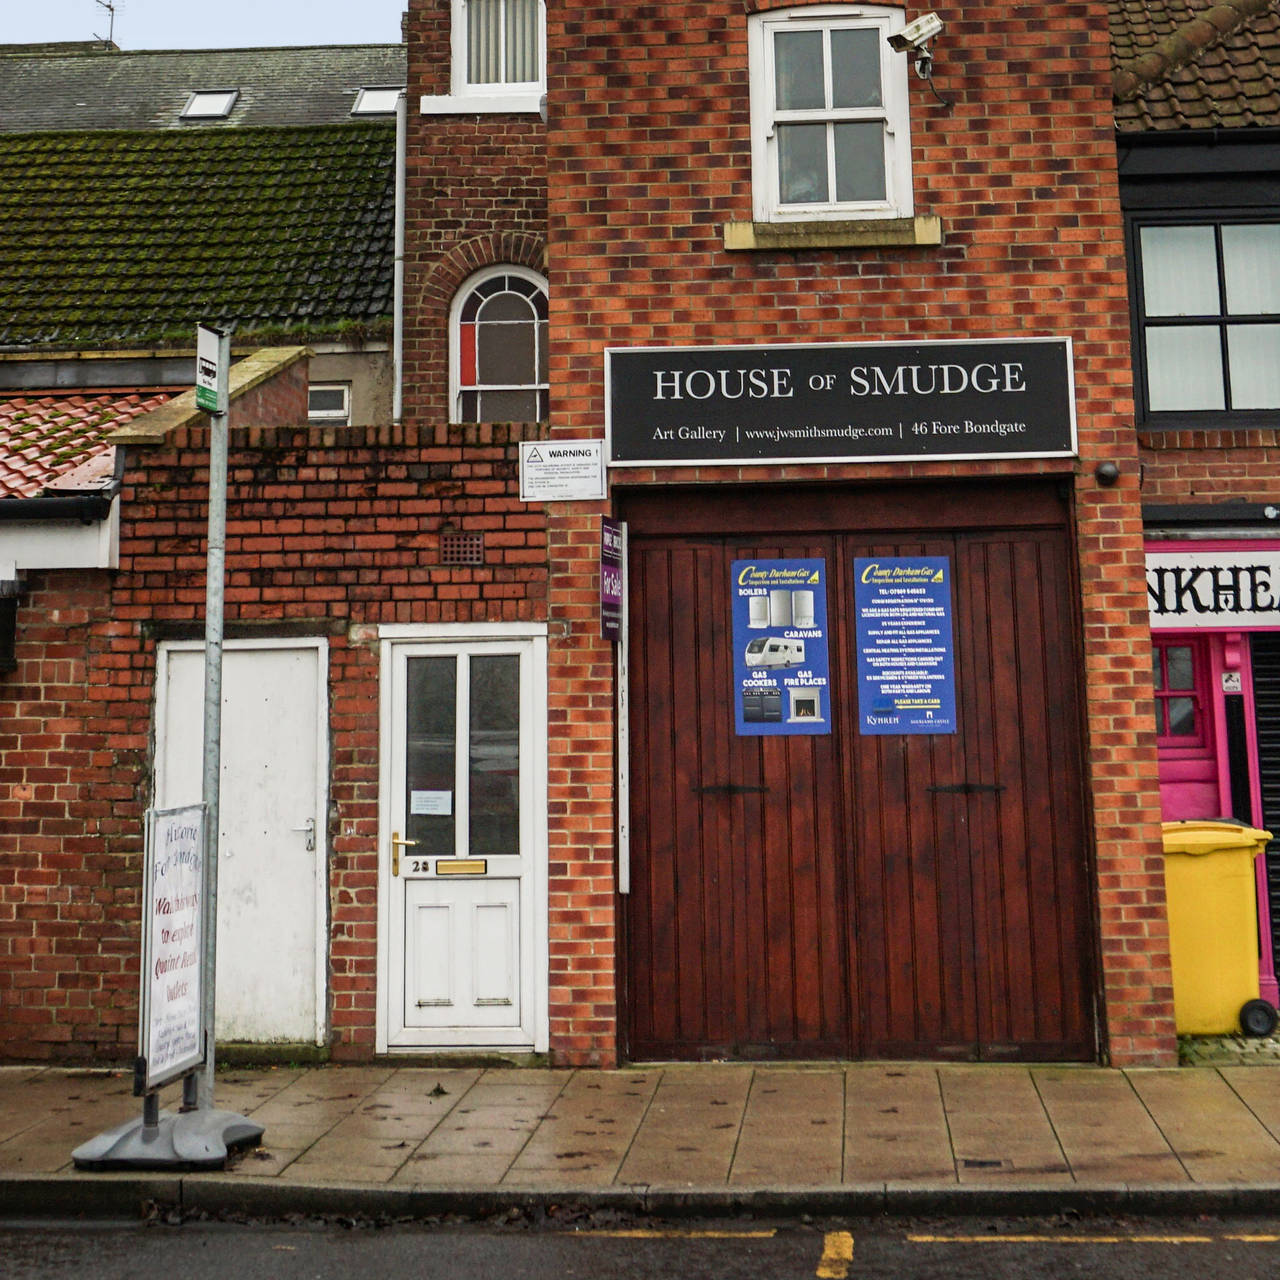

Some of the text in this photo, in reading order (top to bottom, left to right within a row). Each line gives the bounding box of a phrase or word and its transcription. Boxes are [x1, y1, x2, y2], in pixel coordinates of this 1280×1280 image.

[653, 362, 1026, 400] HOUSE OF SMUDGE
[652, 420, 1026, 443] Art Gallery www.jwsmithsmudge.com 46 Fore Bondgate
[548, 449, 592, 458] WARNING
[738, 588, 767, 596] BOILERS
[784, 630, 822, 638] CARAVANS
[752, 671, 767, 679] GAS
[797, 670, 812, 678] GAS
[743, 679, 777, 687] COOKERS
[412, 861, 429, 872] 28
